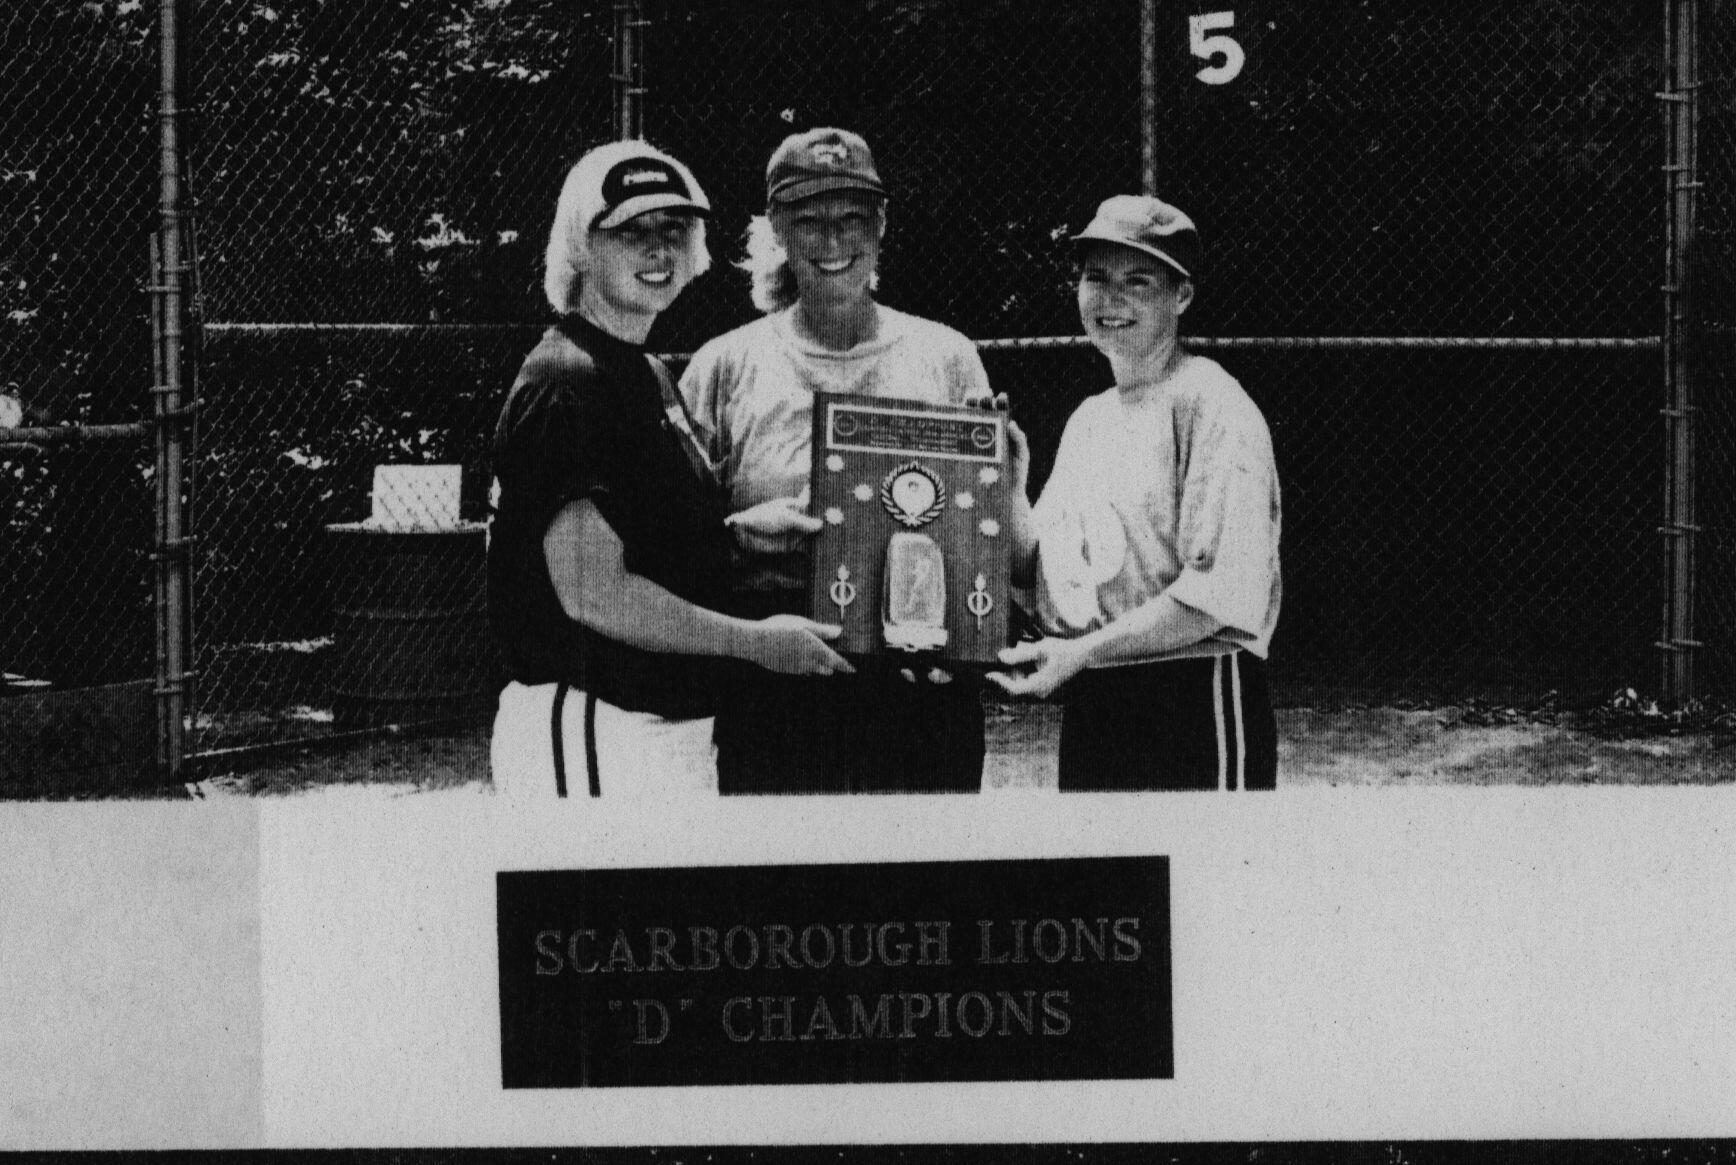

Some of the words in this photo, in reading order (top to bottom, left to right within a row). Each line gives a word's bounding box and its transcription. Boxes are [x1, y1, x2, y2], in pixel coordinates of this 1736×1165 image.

[1189, 11, 1245, 85] 5
[535, 920, 952, 977] SCARBOROUGH
[976, 915, 1142, 965] LIONS
[721, 989, 1072, 1043] CHAMPIONS
